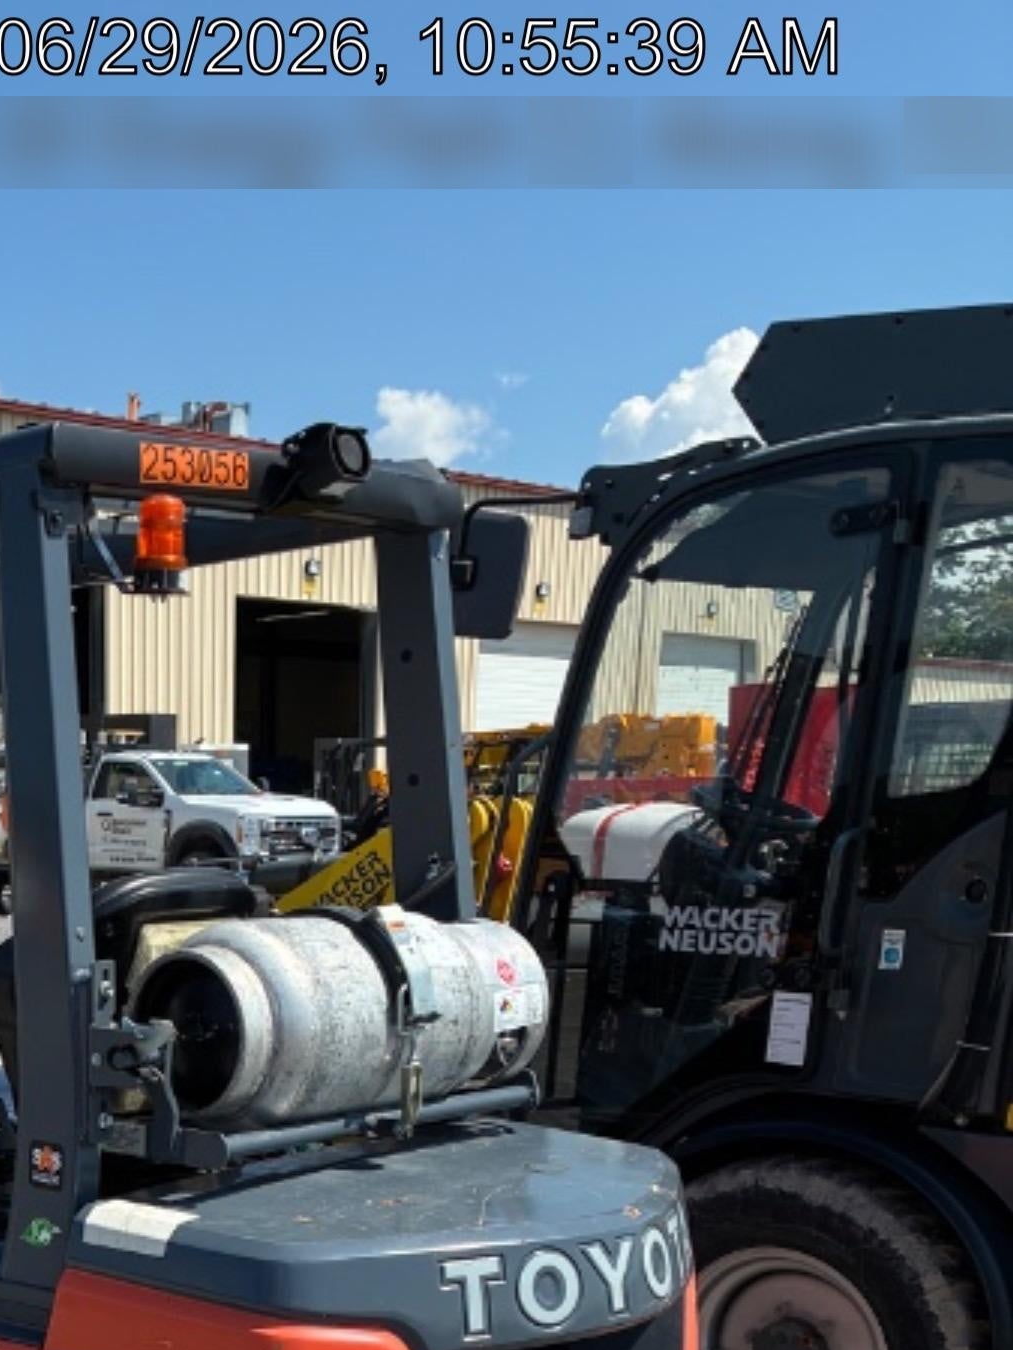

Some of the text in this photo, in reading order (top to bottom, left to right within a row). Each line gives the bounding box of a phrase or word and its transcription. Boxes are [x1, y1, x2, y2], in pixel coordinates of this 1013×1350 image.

[142, 443, 247, 487] 253056
[663, 904, 780, 934] WACKER
[657, 927, 780, 959] NEUSON
